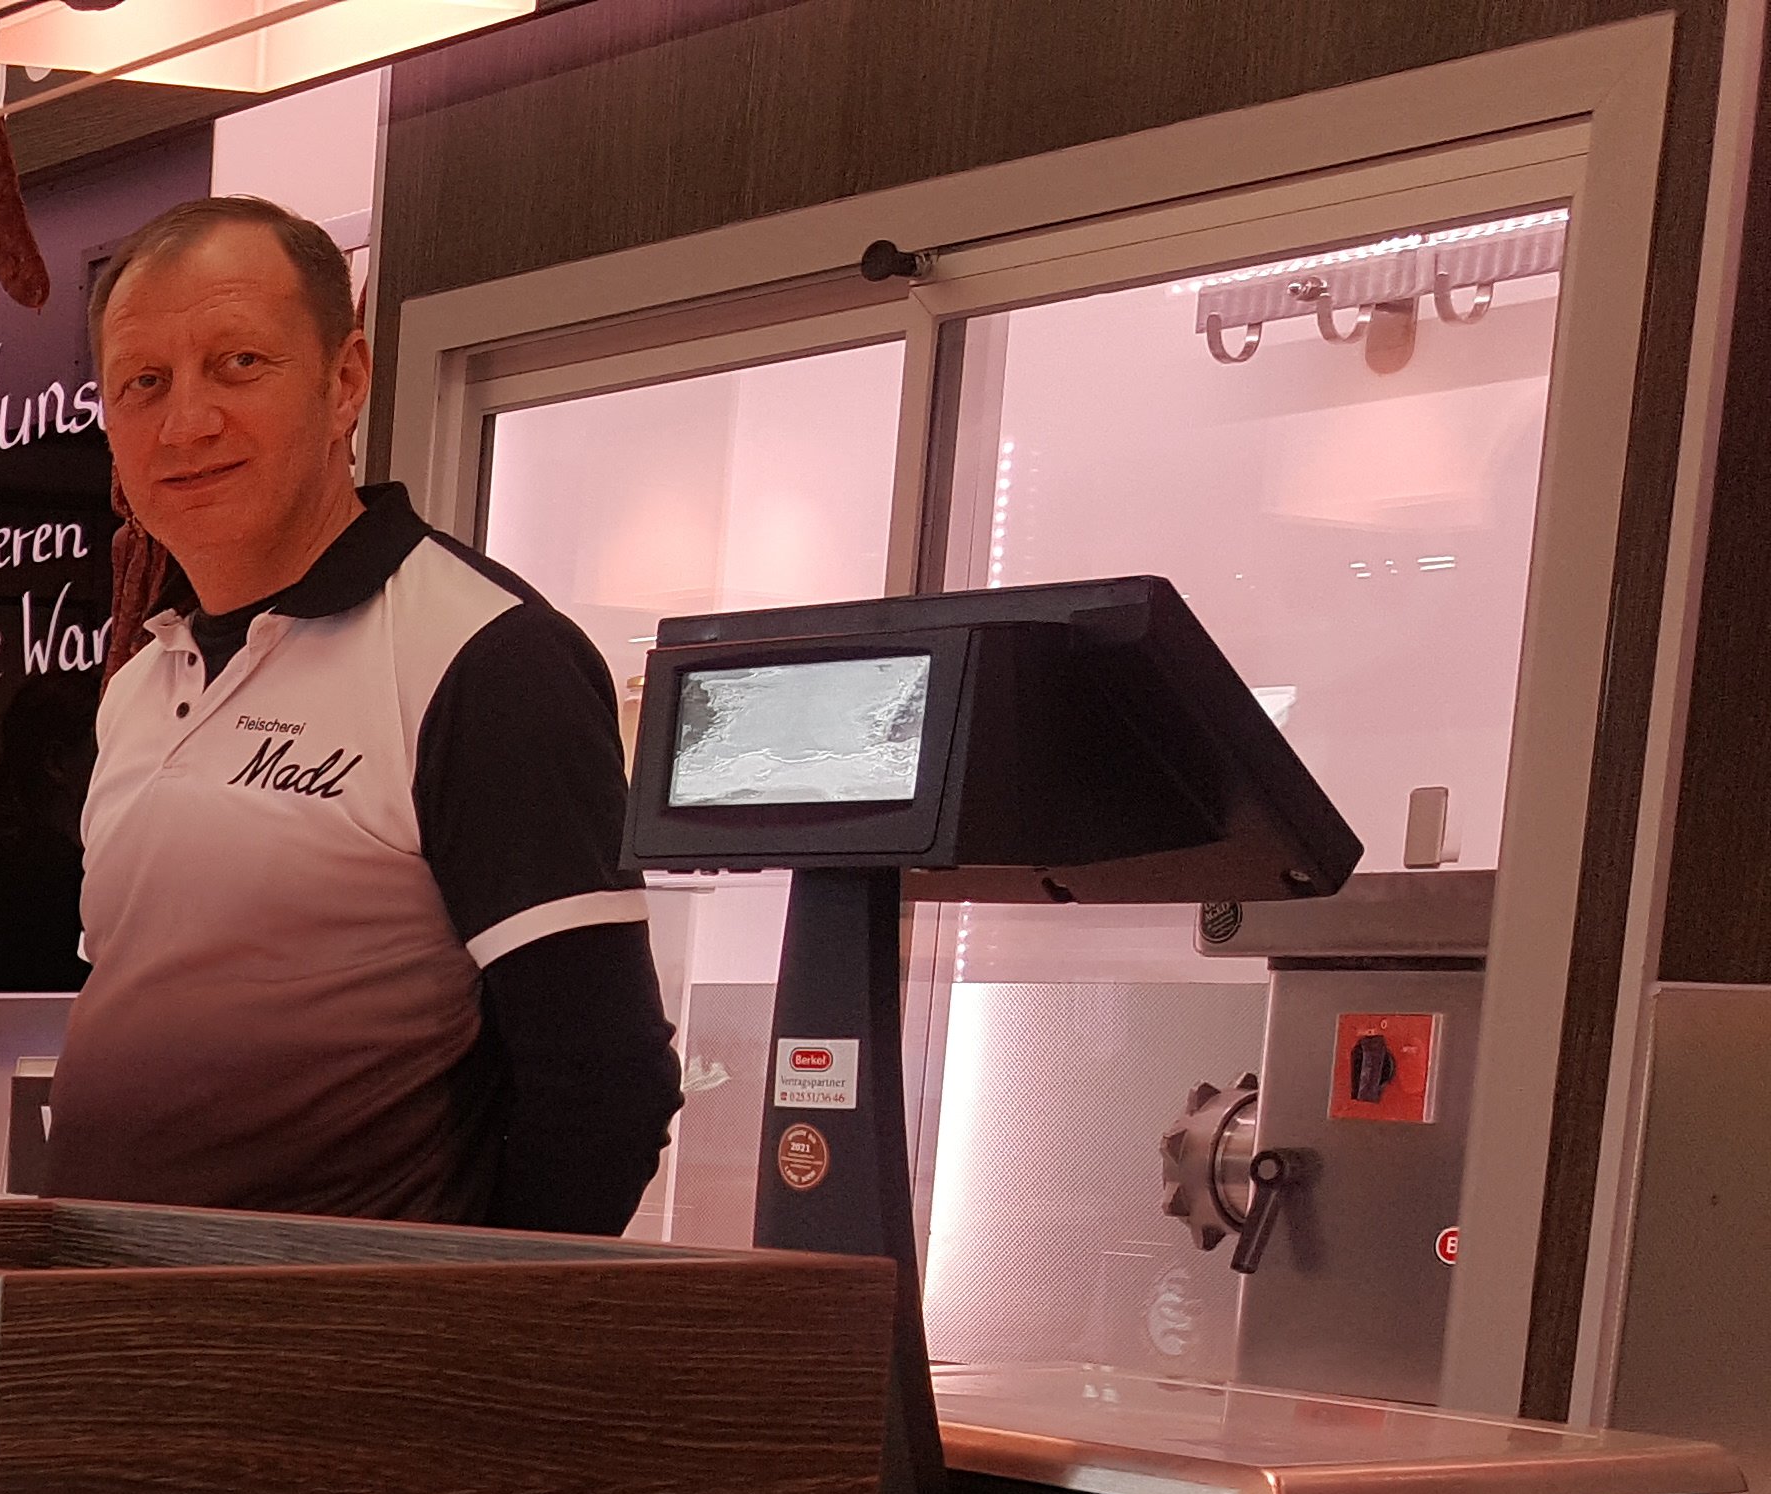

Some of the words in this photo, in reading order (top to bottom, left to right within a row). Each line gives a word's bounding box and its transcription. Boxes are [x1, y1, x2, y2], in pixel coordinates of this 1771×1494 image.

[235, 714, 307, 737] Fleischerei
[227, 737, 363, 799] Madl
[795, 1054, 827, 1066] Berkel
[780, 1075, 846, 1089] Vertragspartner
